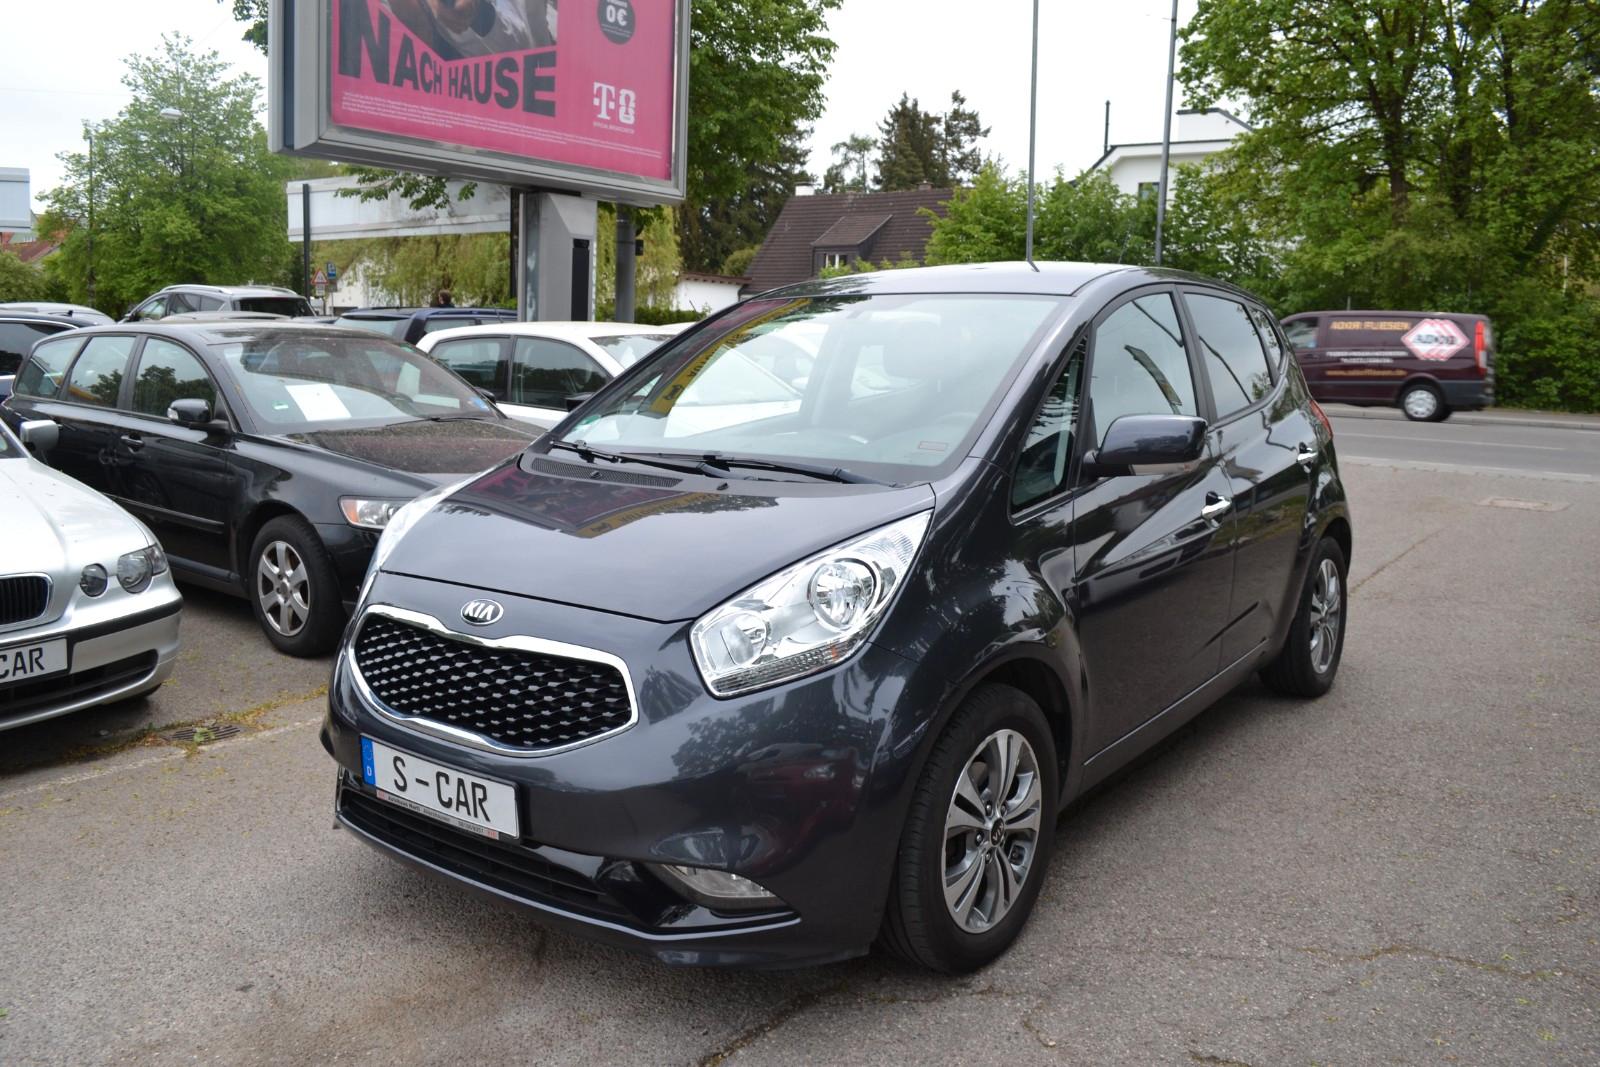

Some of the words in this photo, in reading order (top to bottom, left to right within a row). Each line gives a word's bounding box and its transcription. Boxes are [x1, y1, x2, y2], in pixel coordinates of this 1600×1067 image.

[338, 0, 443, 95] NACH
[448, 51, 557, 117] HAUSE
[463, 602, 494, 621] KIA
